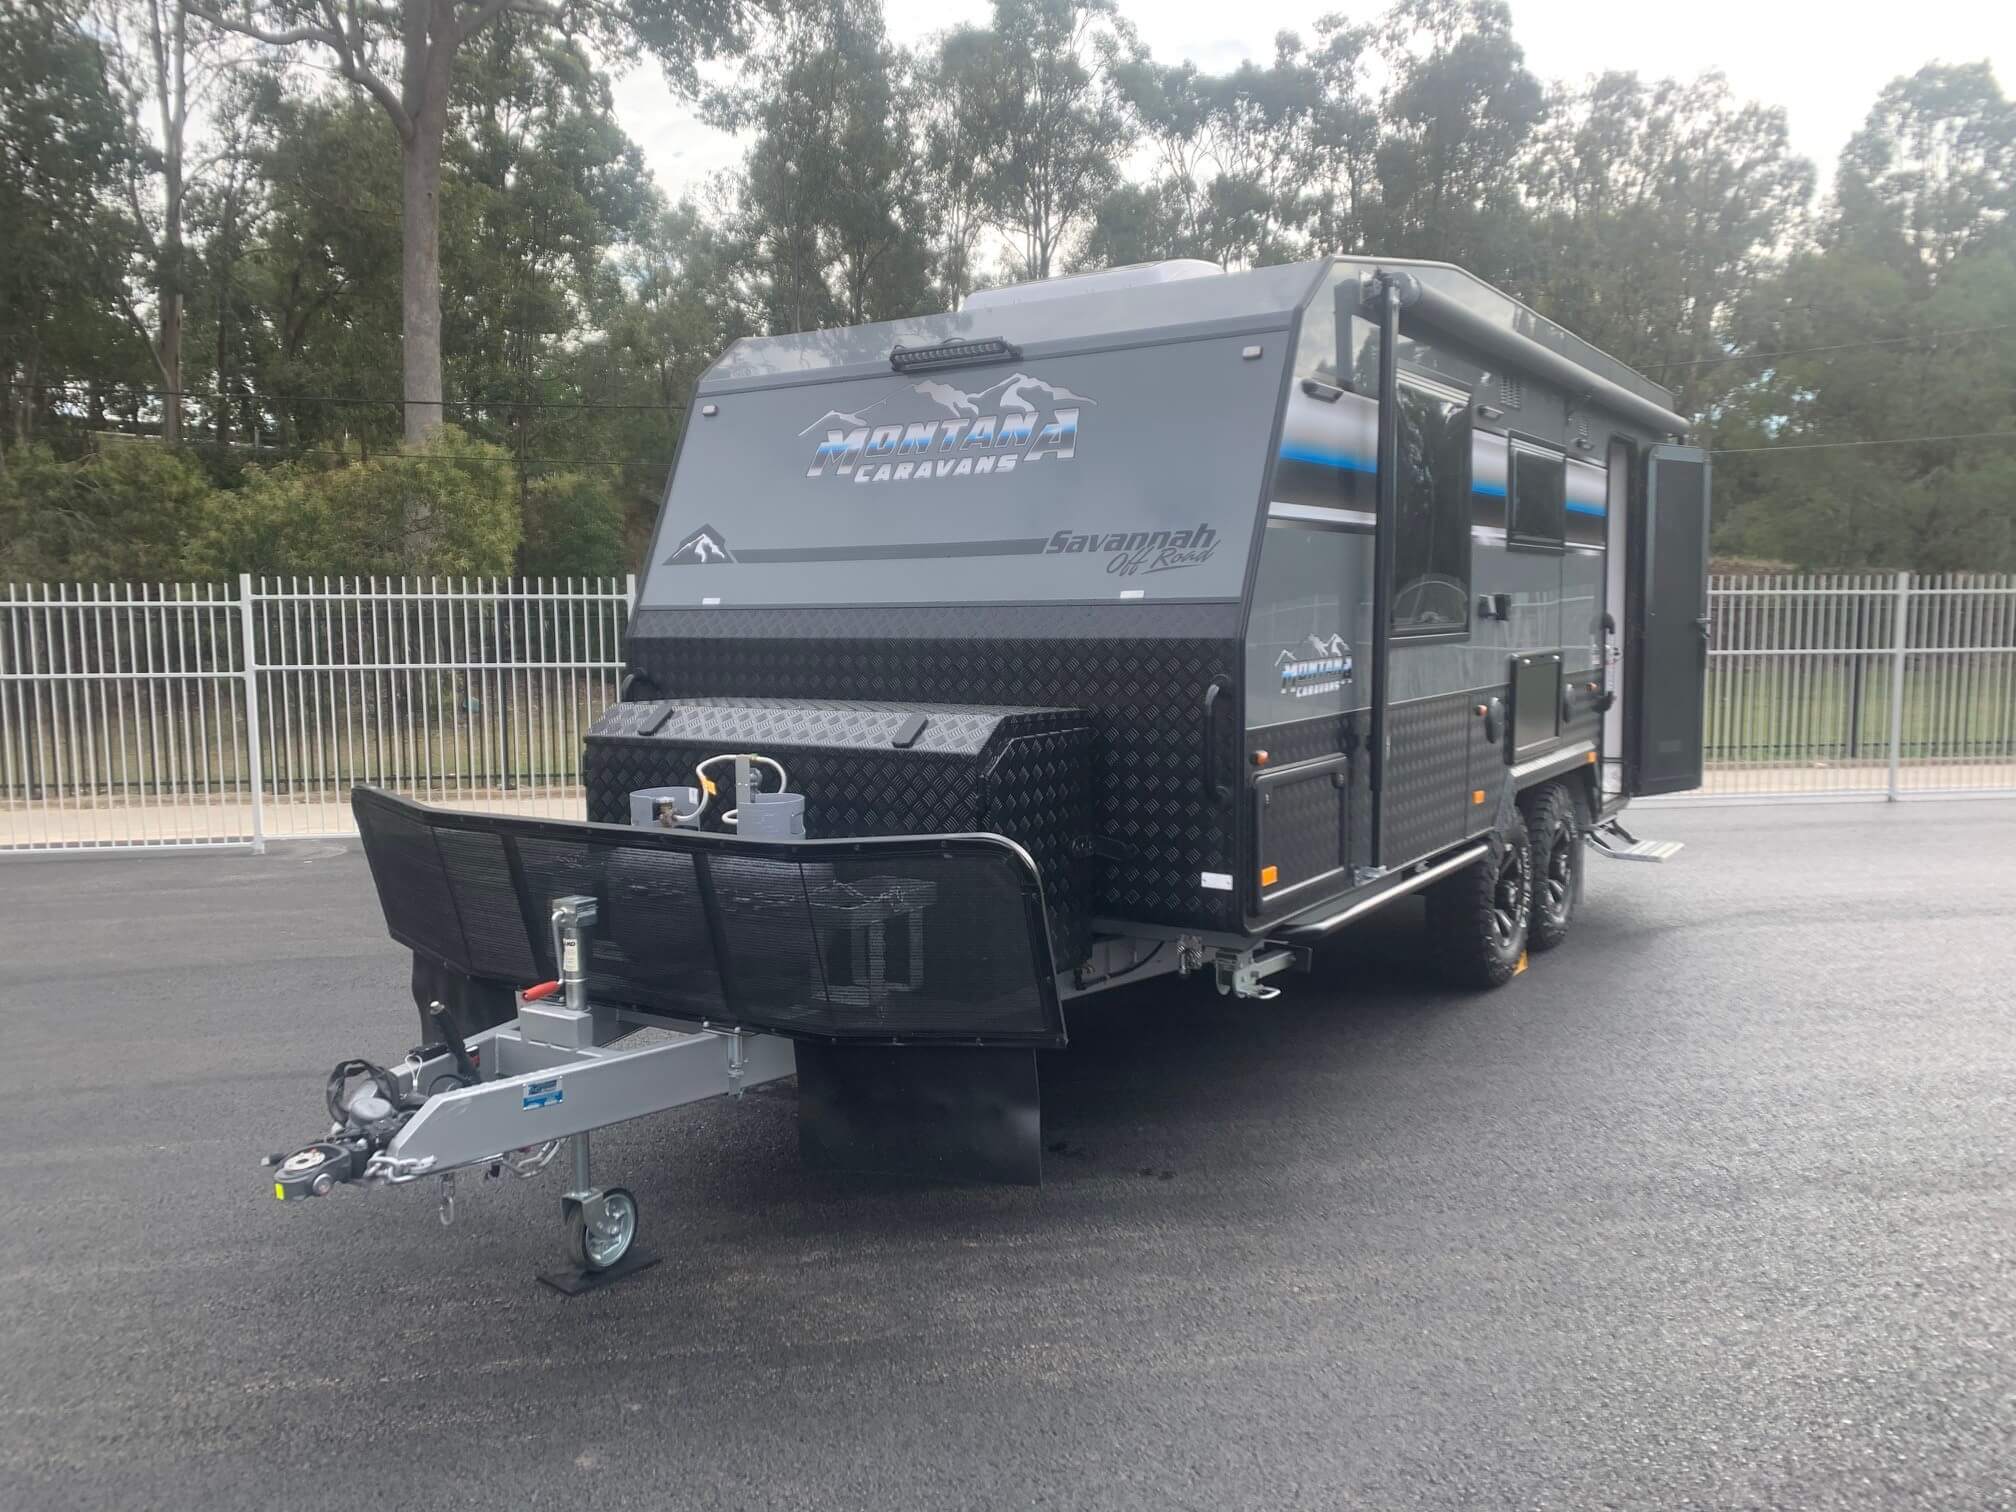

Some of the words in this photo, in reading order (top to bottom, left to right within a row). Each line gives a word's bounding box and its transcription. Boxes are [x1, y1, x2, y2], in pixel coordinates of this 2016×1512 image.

[806, 408, 1079, 478] MONTANA
[854, 453, 1018, 483] CARAVANS
[1046, 523, 1217, 554] Savannah
[1106, 549, 1152, 577] Off
[1145, 541, 1220, 573] Road
[1280, 656, 1352, 694] MONTANA
